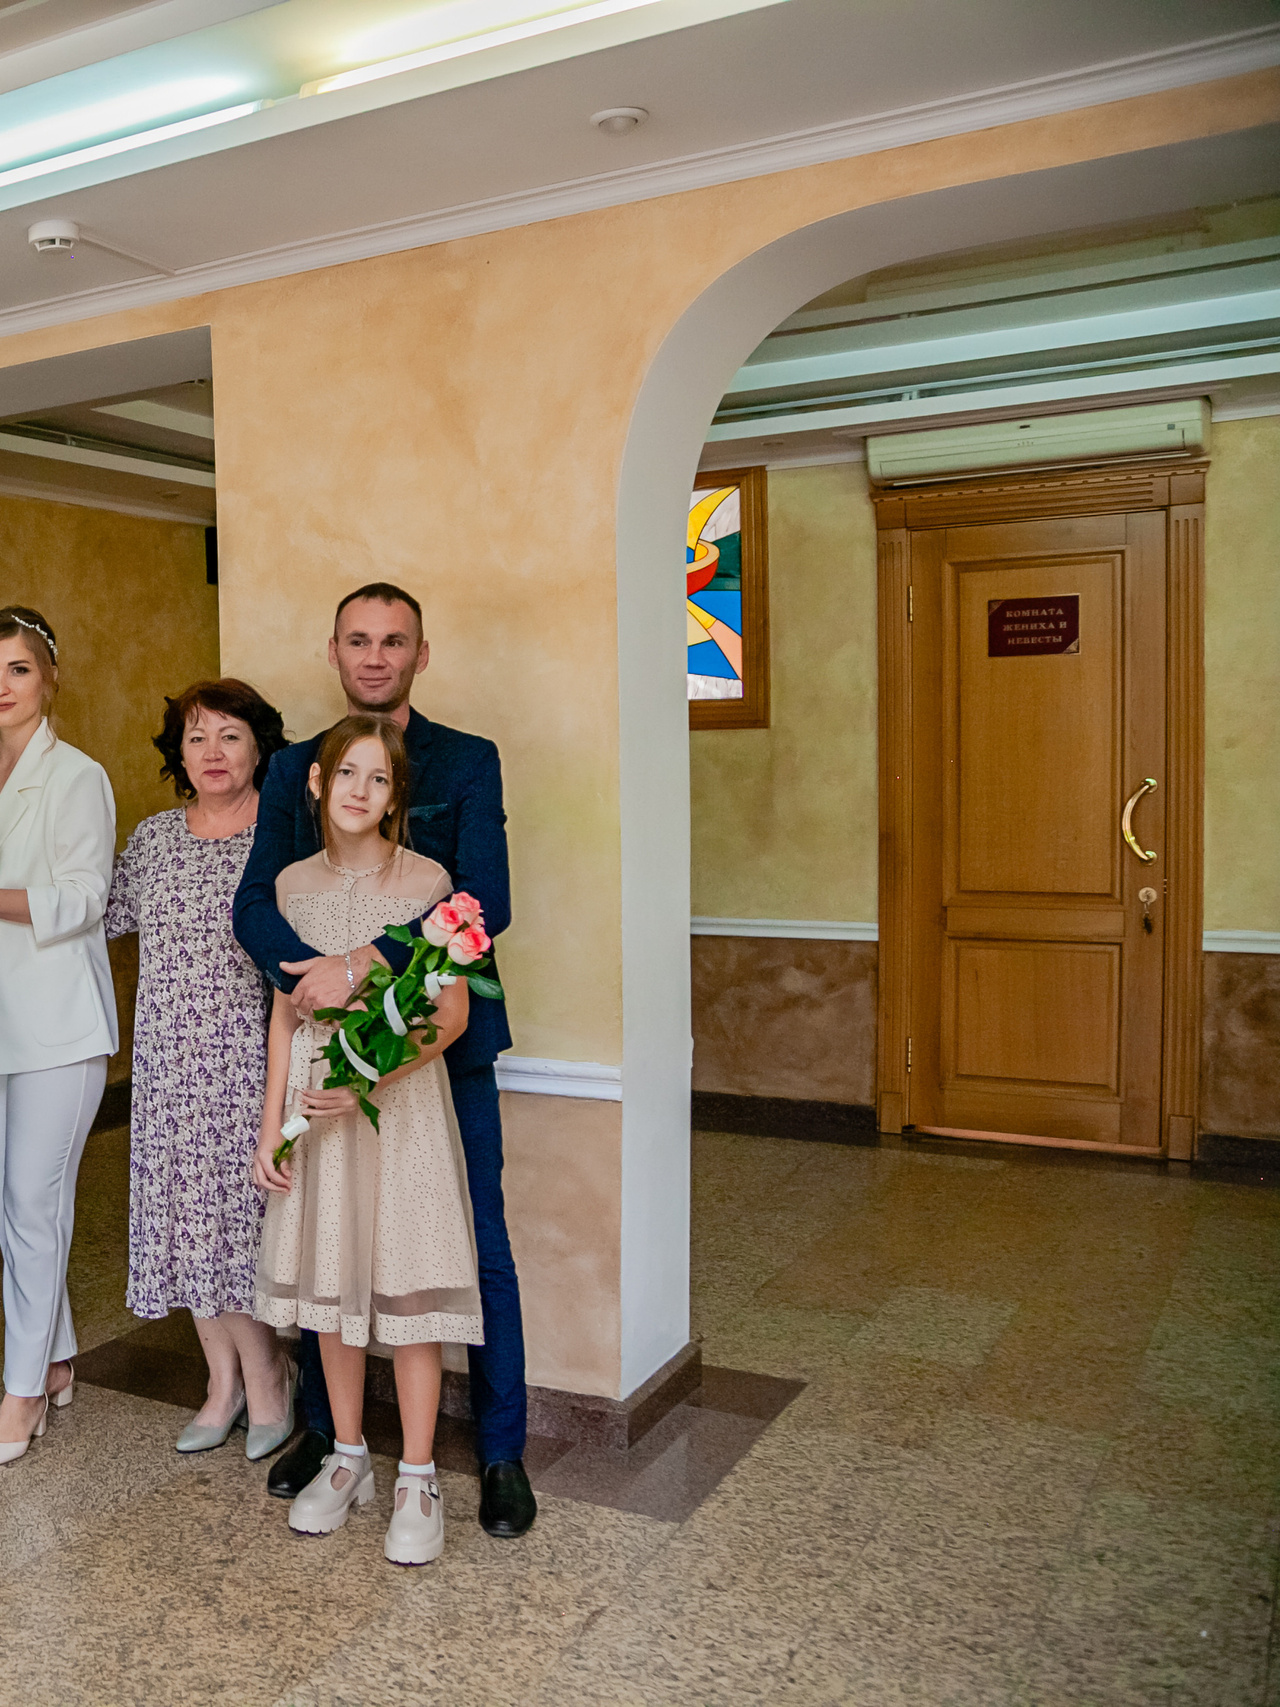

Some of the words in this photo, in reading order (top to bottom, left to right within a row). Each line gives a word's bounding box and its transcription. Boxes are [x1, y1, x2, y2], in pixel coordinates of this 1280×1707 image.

[1006, 608, 1064, 618] КОМНАТА
[1003, 622, 1055, 631] ЖЕНИХА
[1059, 621, 1067, 629] И
[1007, 635, 1062, 645] НЕВЕСТЫ
